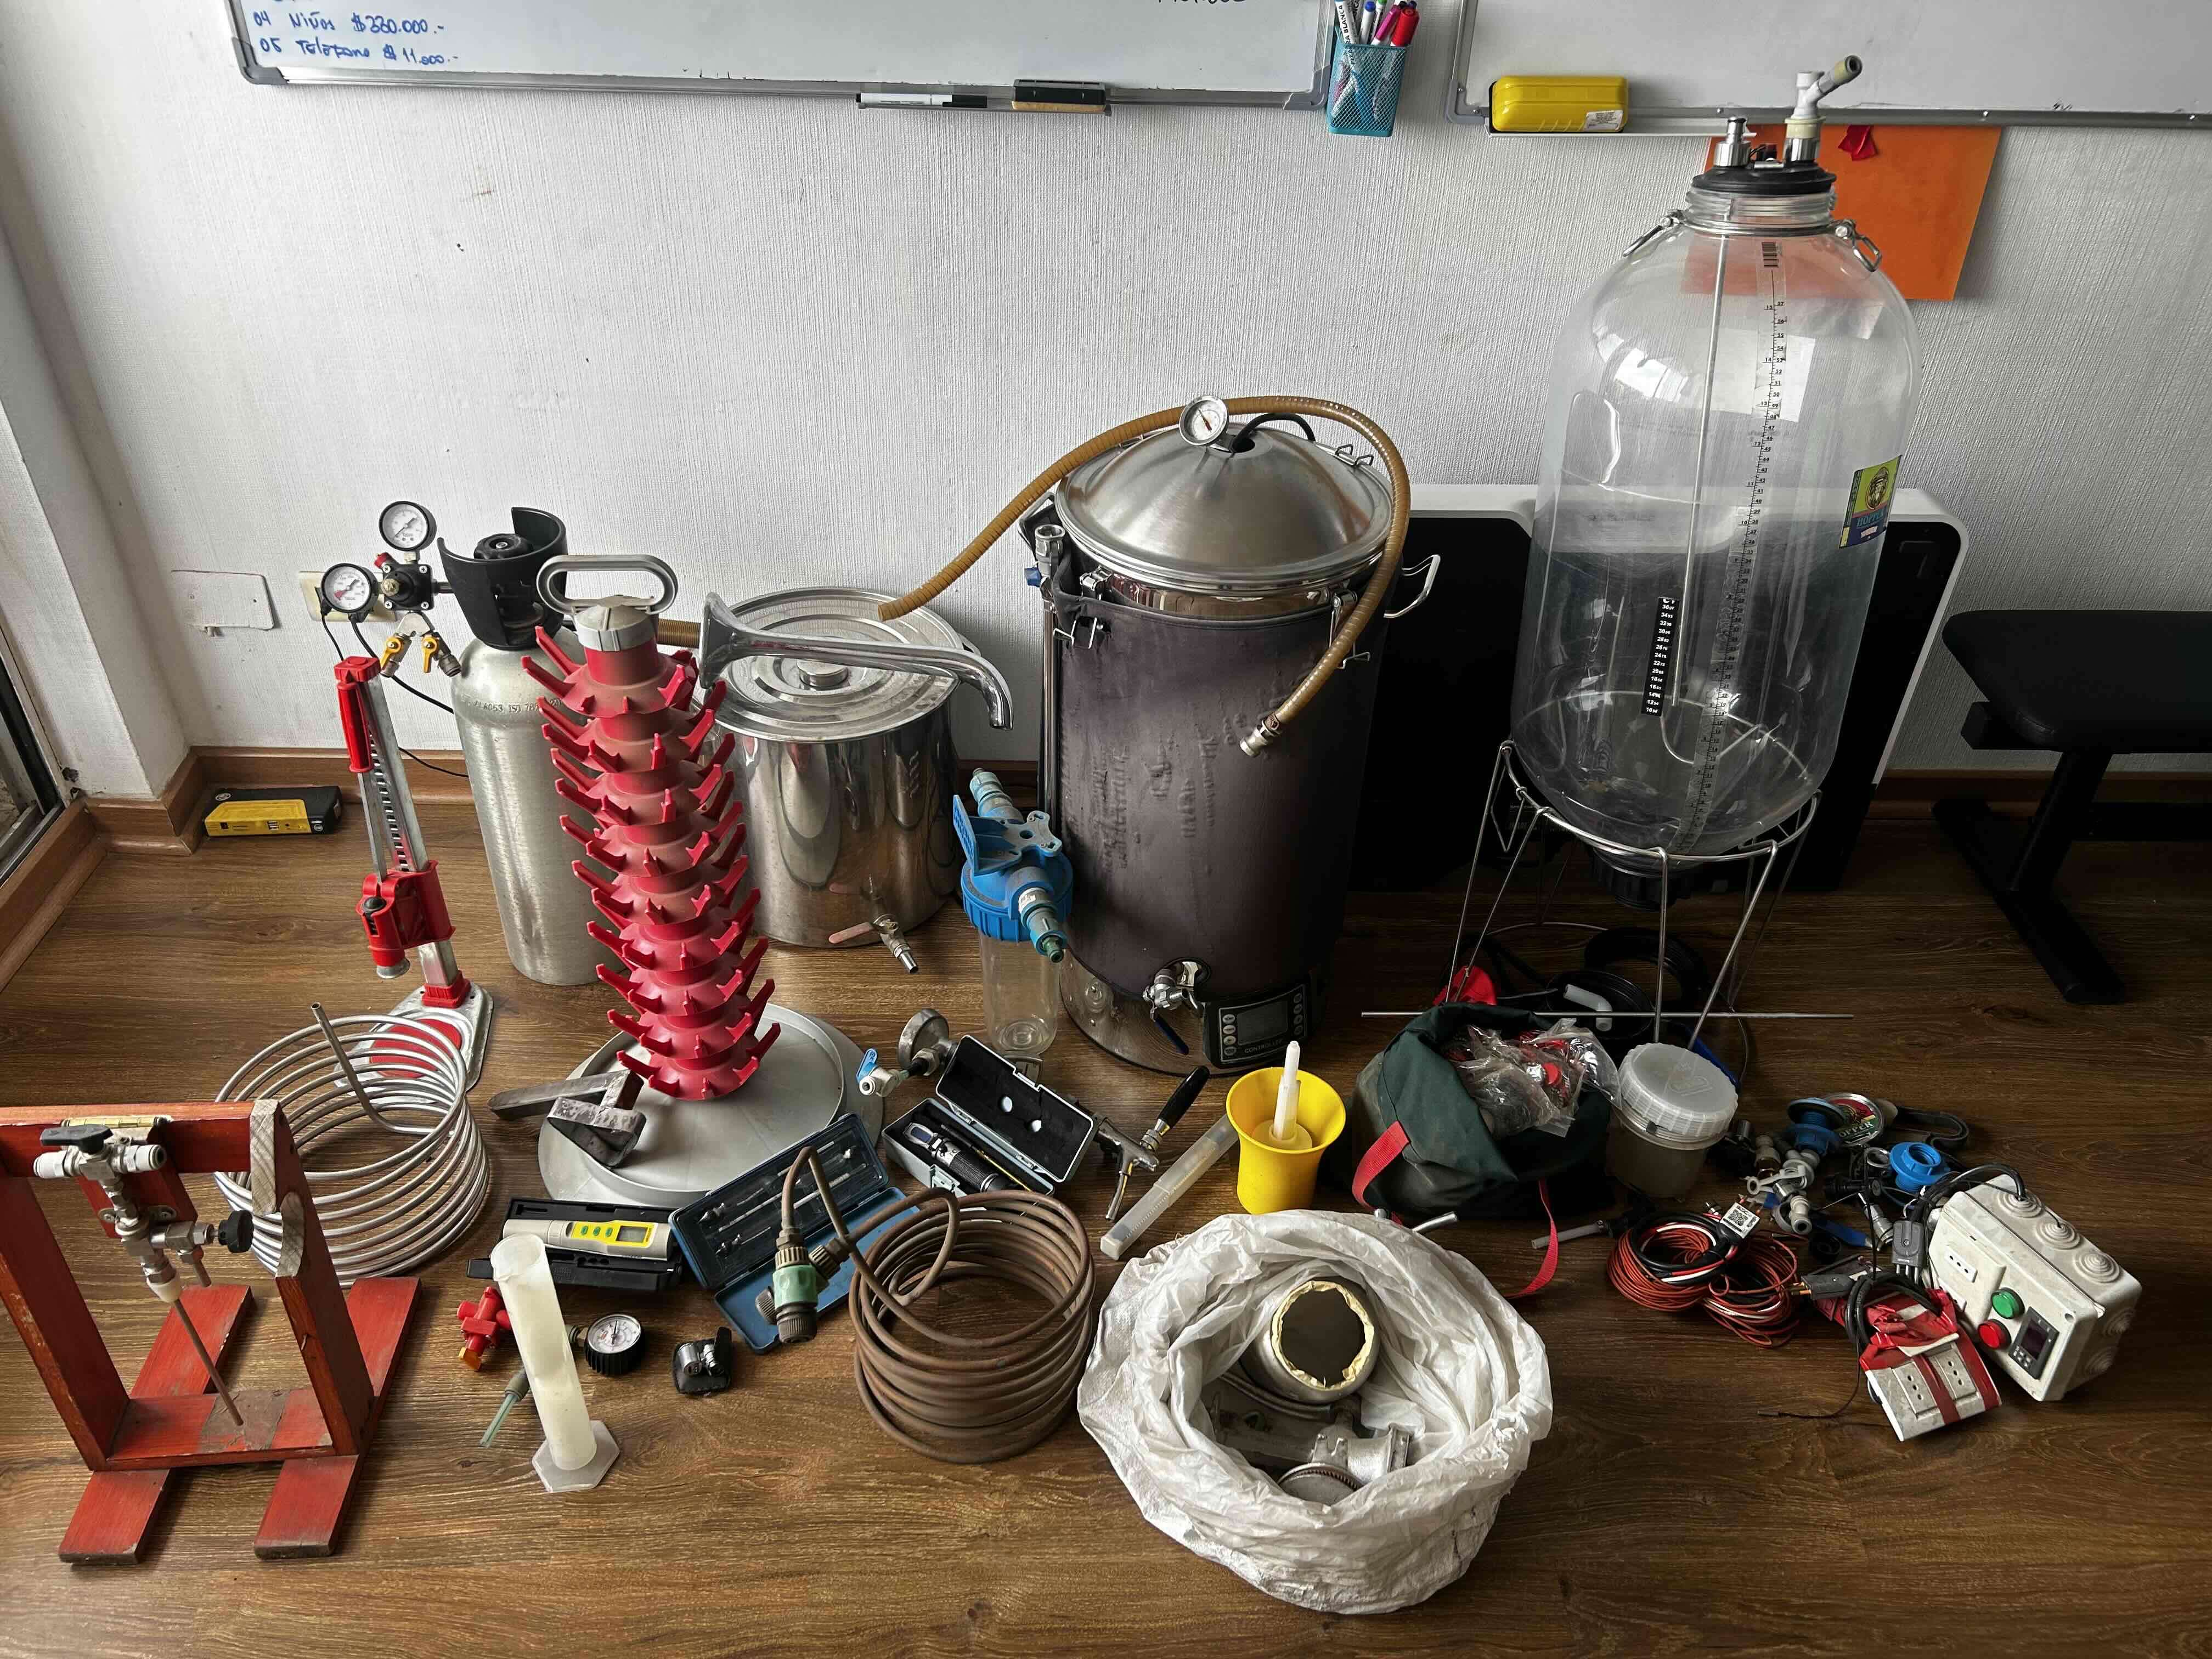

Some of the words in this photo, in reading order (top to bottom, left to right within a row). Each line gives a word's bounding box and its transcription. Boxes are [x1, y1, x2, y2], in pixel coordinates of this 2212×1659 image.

[253, 10, 272, 26] 04
[259, 36, 281, 53] 05
[1838, 1121, 1875, 1137] OPPER
